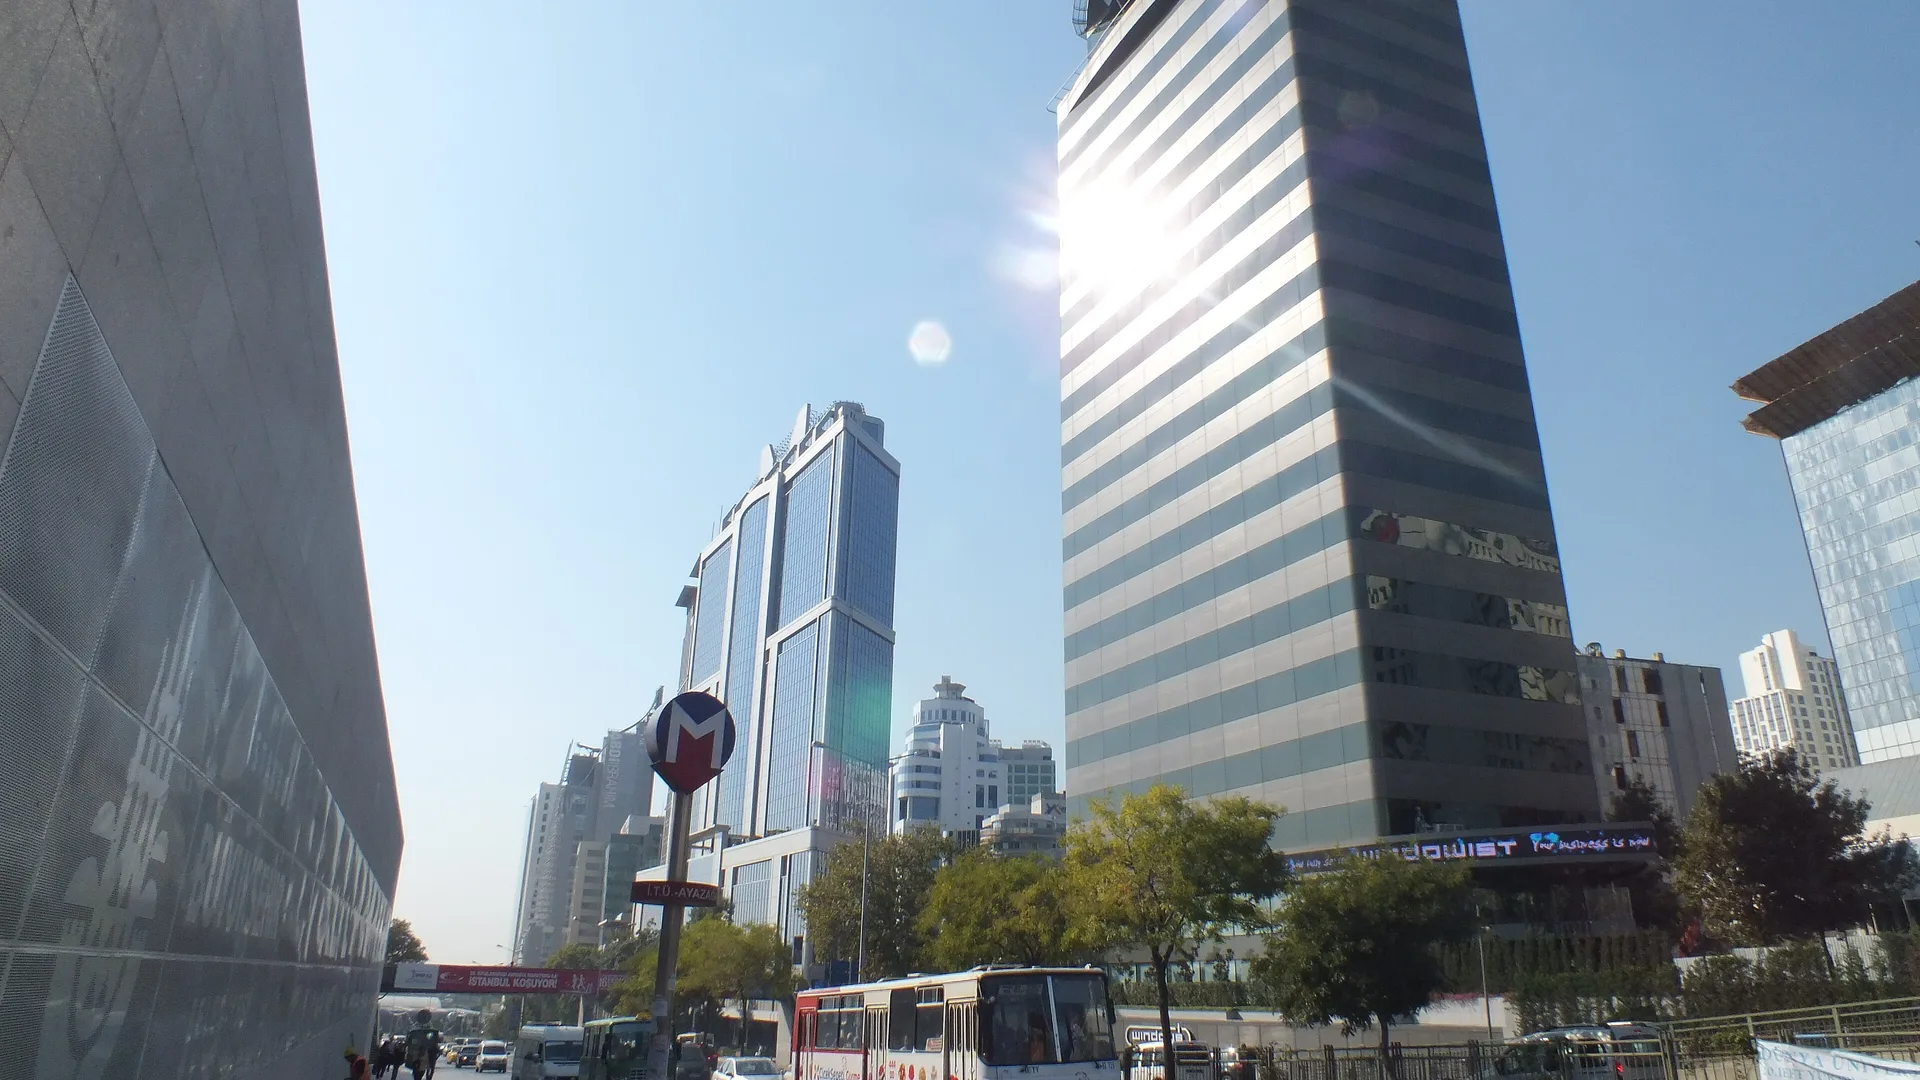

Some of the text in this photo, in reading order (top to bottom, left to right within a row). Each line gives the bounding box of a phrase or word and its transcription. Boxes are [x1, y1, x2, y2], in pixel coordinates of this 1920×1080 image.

[1612, 838, 1624, 847] is
[1628, 837, 1649, 847] now
[468, 975, 510, 987] İSTANBUL
